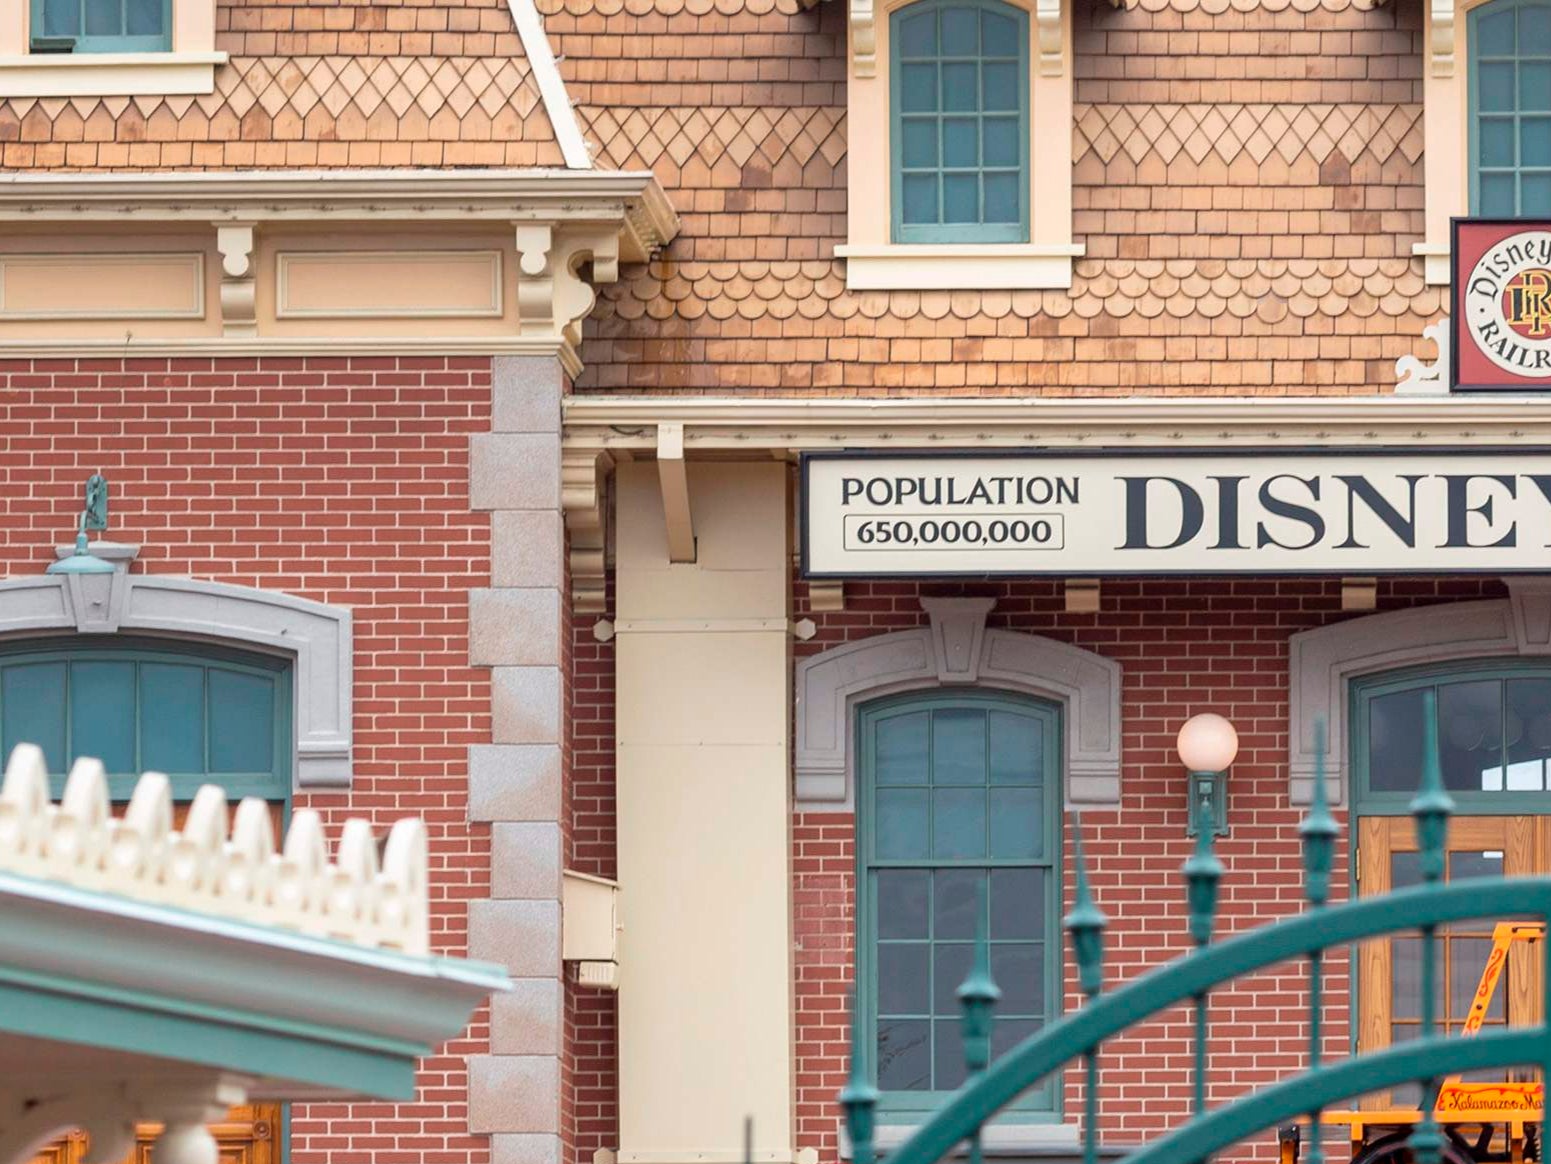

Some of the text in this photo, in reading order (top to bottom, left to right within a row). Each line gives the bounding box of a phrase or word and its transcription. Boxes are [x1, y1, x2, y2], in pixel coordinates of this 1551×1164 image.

[841, 476, 1080, 506] POPULATION
[857, 520, 1052, 546] 650,000,000
[1449, 1092, 1519, 1111] Kalamazoo
